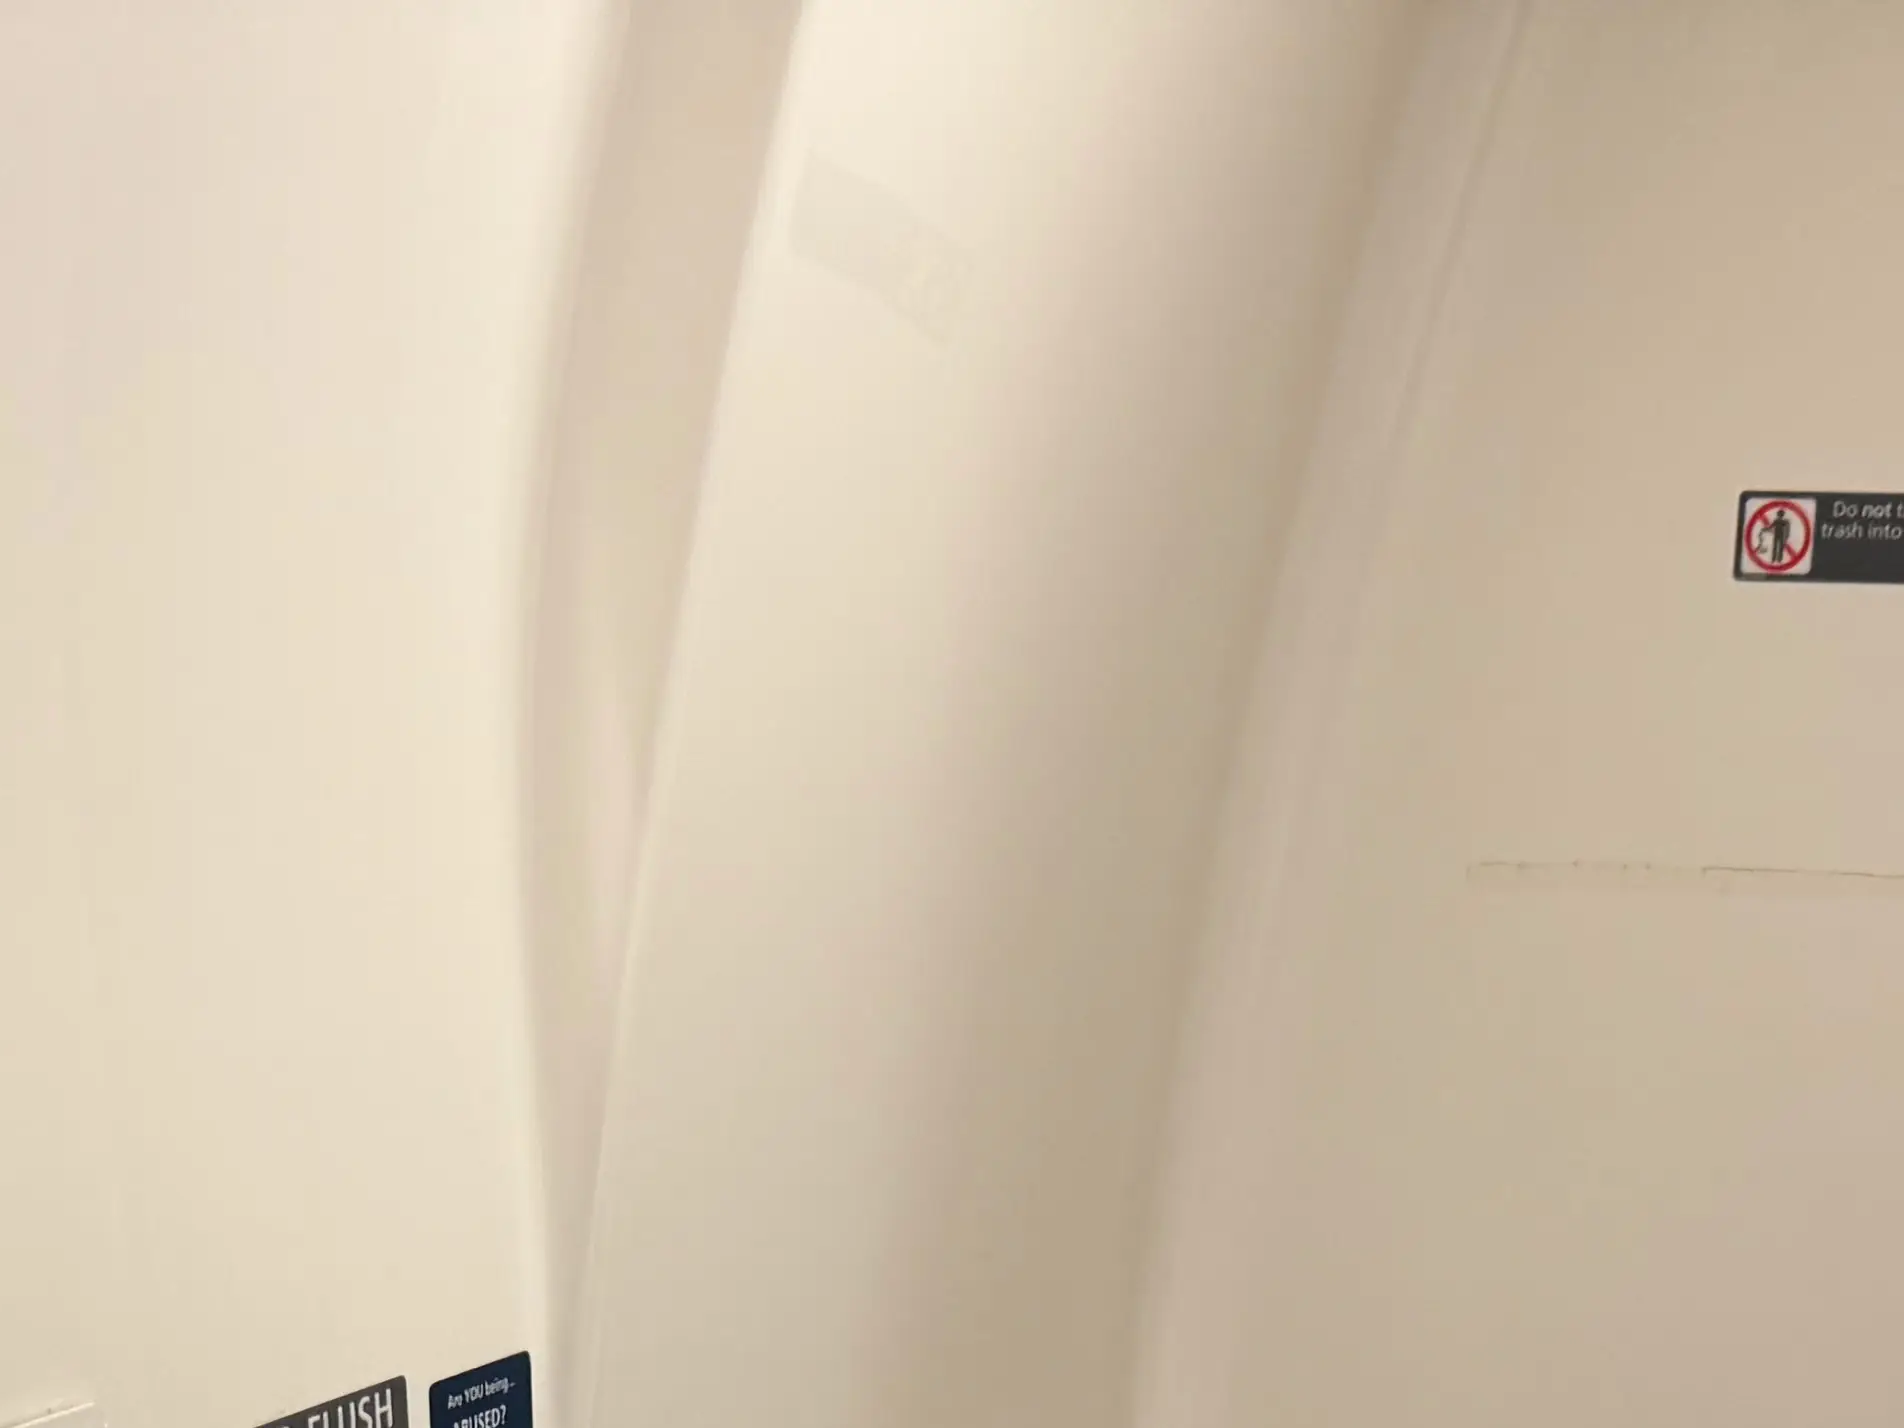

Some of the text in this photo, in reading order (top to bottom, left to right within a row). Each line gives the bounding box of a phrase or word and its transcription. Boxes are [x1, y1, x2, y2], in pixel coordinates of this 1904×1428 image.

[1833, 500, 1858, 518] Do
[1861, 501, 1892, 519] not
[1821, 521, 1863, 539] trash
[1867, 522, 1903, 539] into
[464, 1383, 483, 1403] YOU
